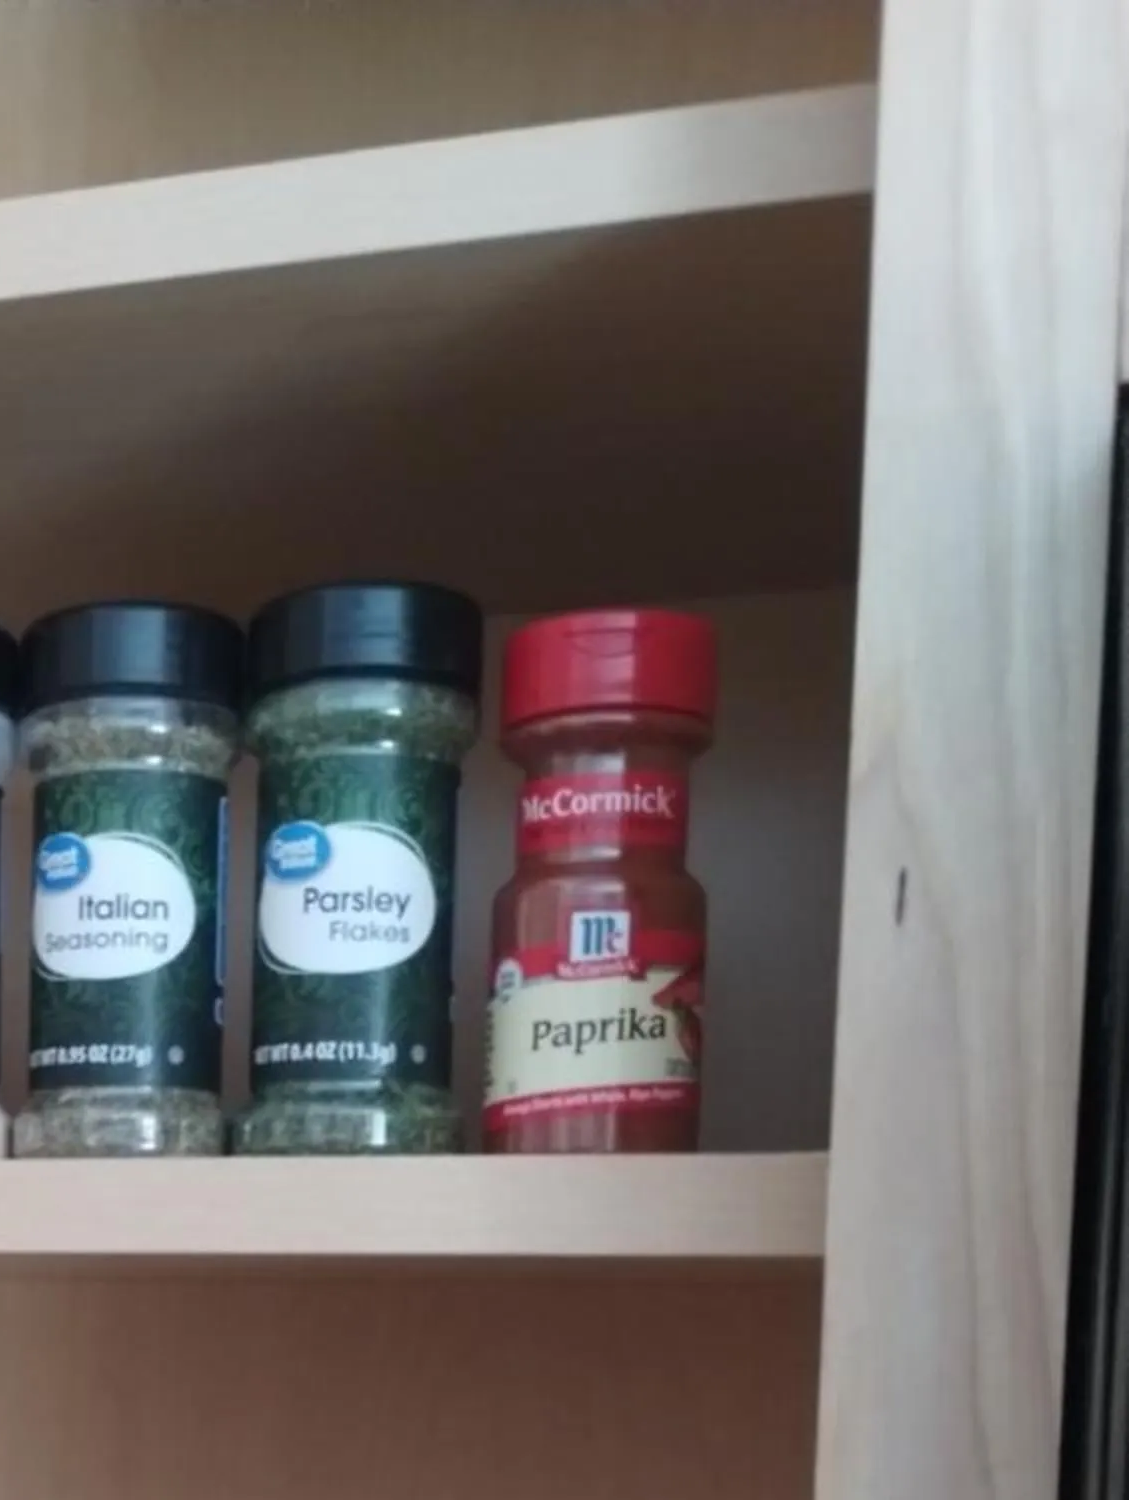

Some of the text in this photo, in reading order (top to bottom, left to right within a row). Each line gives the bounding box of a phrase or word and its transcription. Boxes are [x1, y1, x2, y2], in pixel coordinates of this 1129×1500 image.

[523, 784, 675, 823] McCormick
[78, 895, 169, 921] Italian
[303, 886, 412, 919] Parsley
[45, 928, 169, 954] Seasoning
[329, 920, 411, 944] Flakes
[532, 1007, 667, 1055] Paprika
[315, 1040, 337, 1060] OZ
